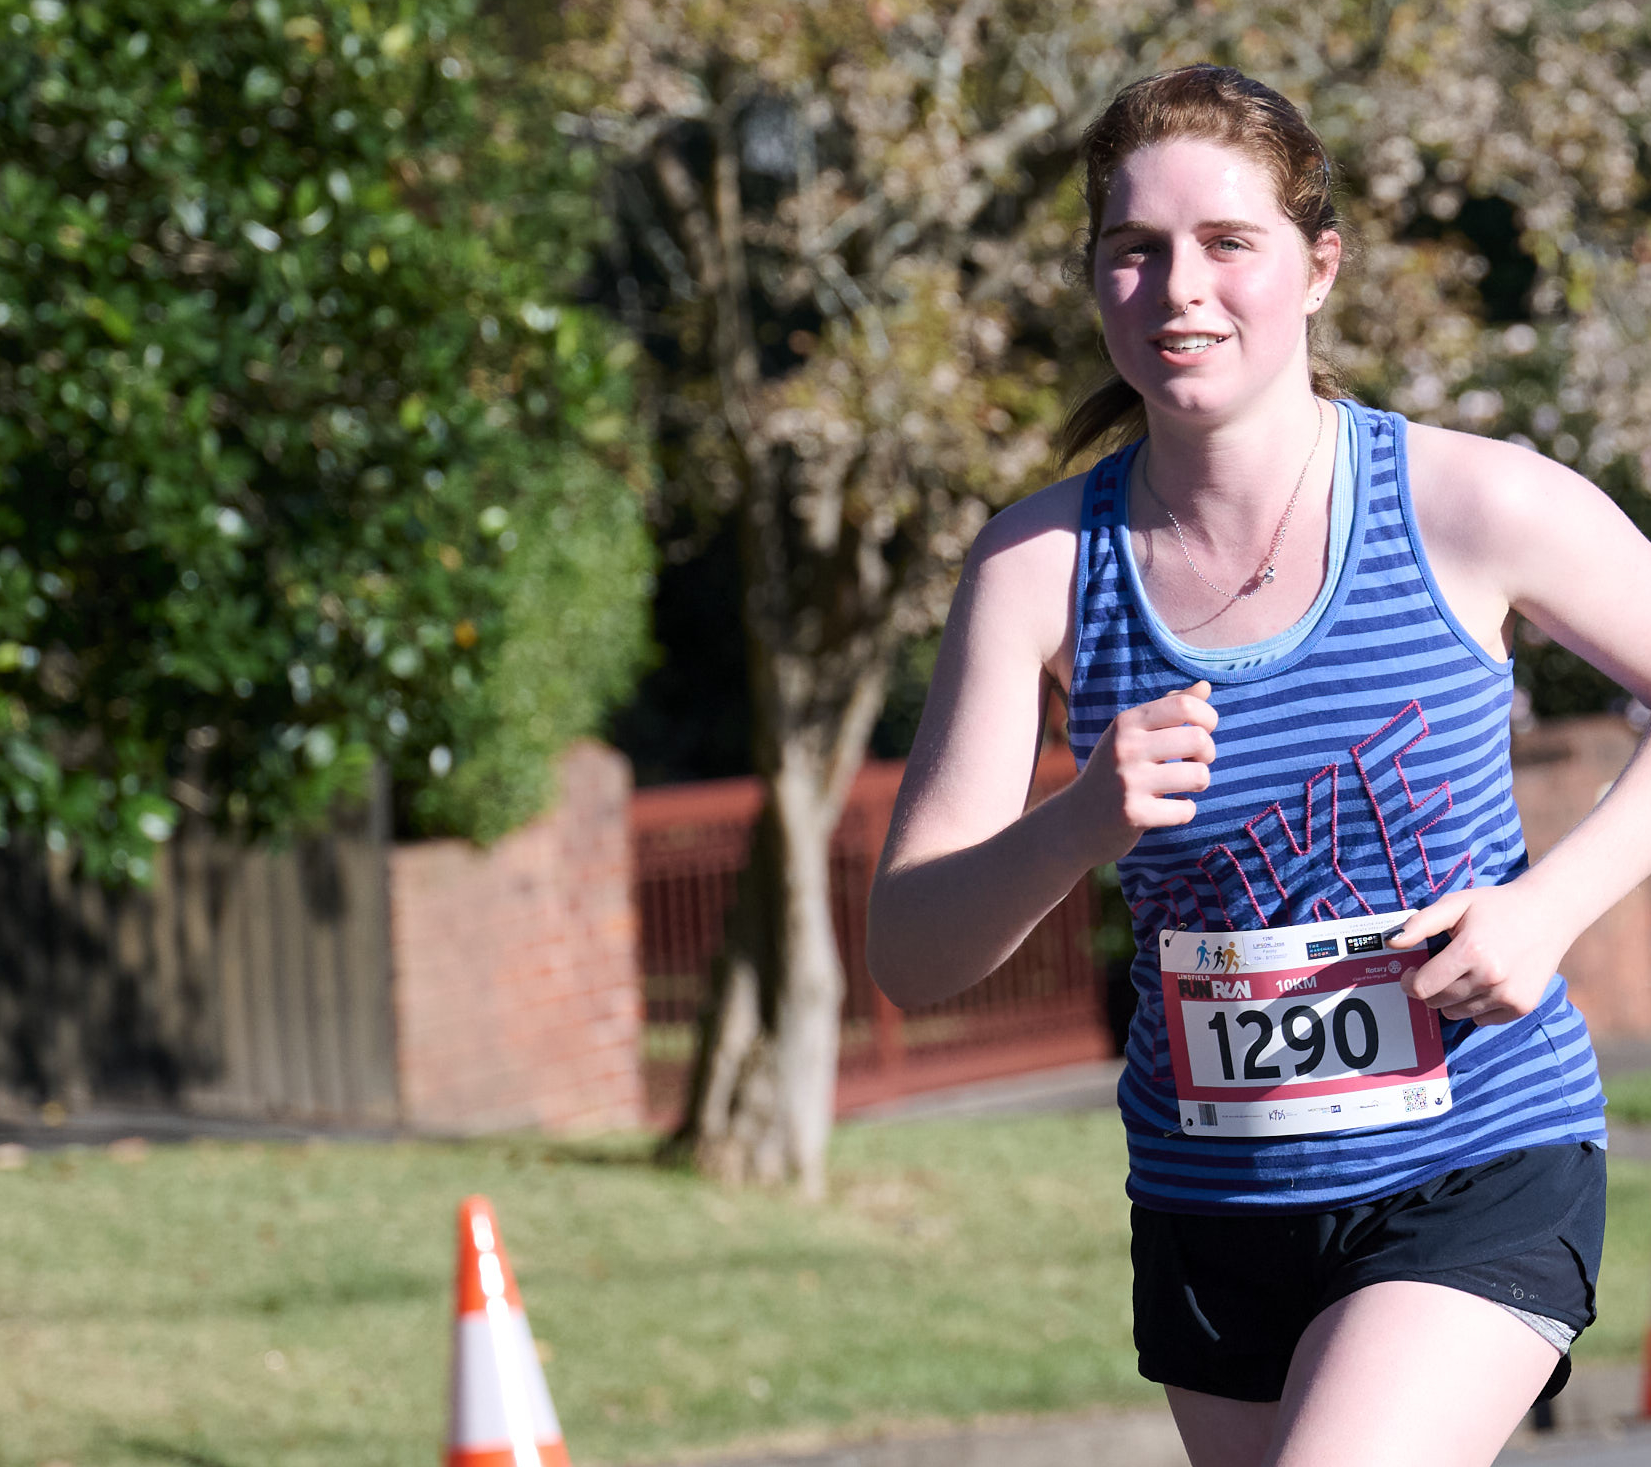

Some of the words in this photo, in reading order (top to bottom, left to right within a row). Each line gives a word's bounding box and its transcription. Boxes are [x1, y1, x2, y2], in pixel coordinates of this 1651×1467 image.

[1177, 973, 1210, 981] LINDFIELD
[1275, 976, 1317, 992] 10KM
[1208, 998, 1379, 1080] 1290
